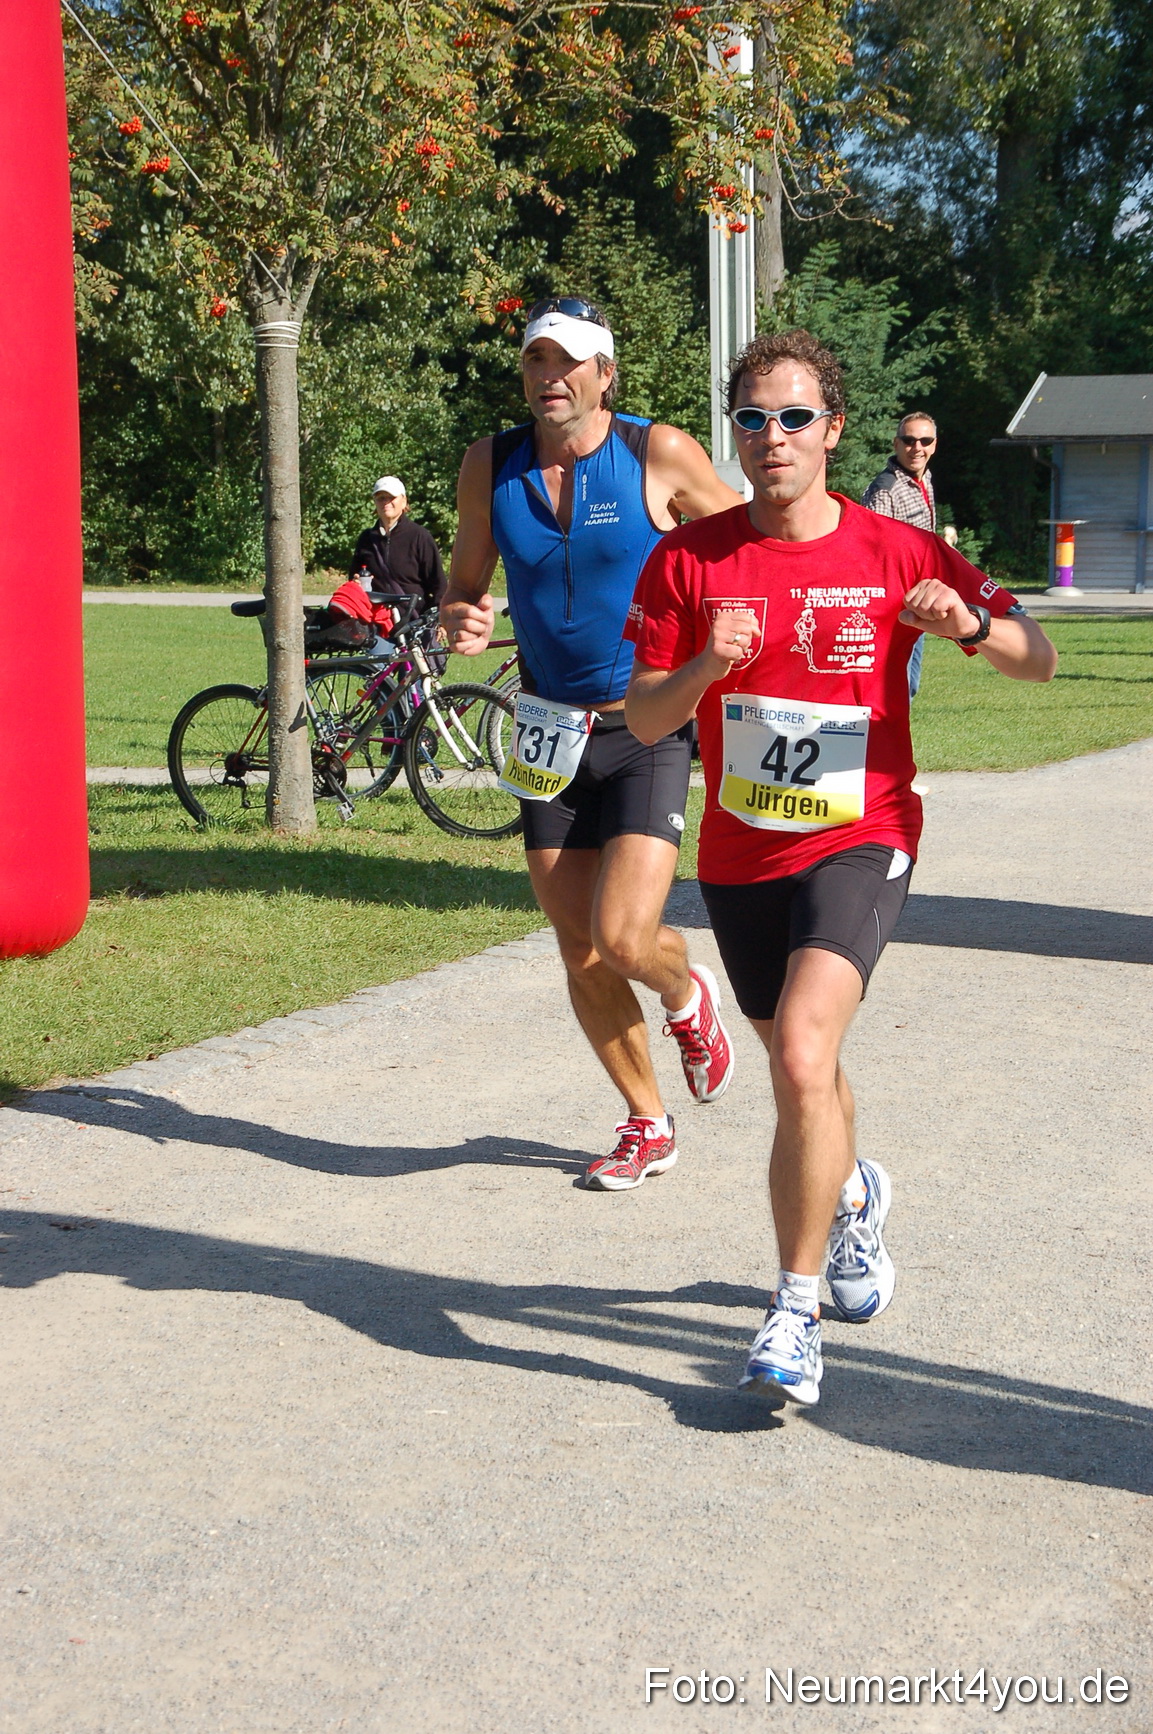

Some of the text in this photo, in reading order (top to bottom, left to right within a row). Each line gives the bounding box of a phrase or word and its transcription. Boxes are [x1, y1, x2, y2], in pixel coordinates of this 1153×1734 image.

[589, 501, 617, 512] TEAM
[584, 517, 620, 526] HARRER
[790, 587, 886, 599] 11. NEUMARKTER
[804, 597, 870, 608] STADTLAUF
[744, 705, 805, 724] PFLEIDERER
[516, 721, 561, 768] 731
[760, 735, 820, 786] 42
[745, 783, 829, 819] Jürgen
